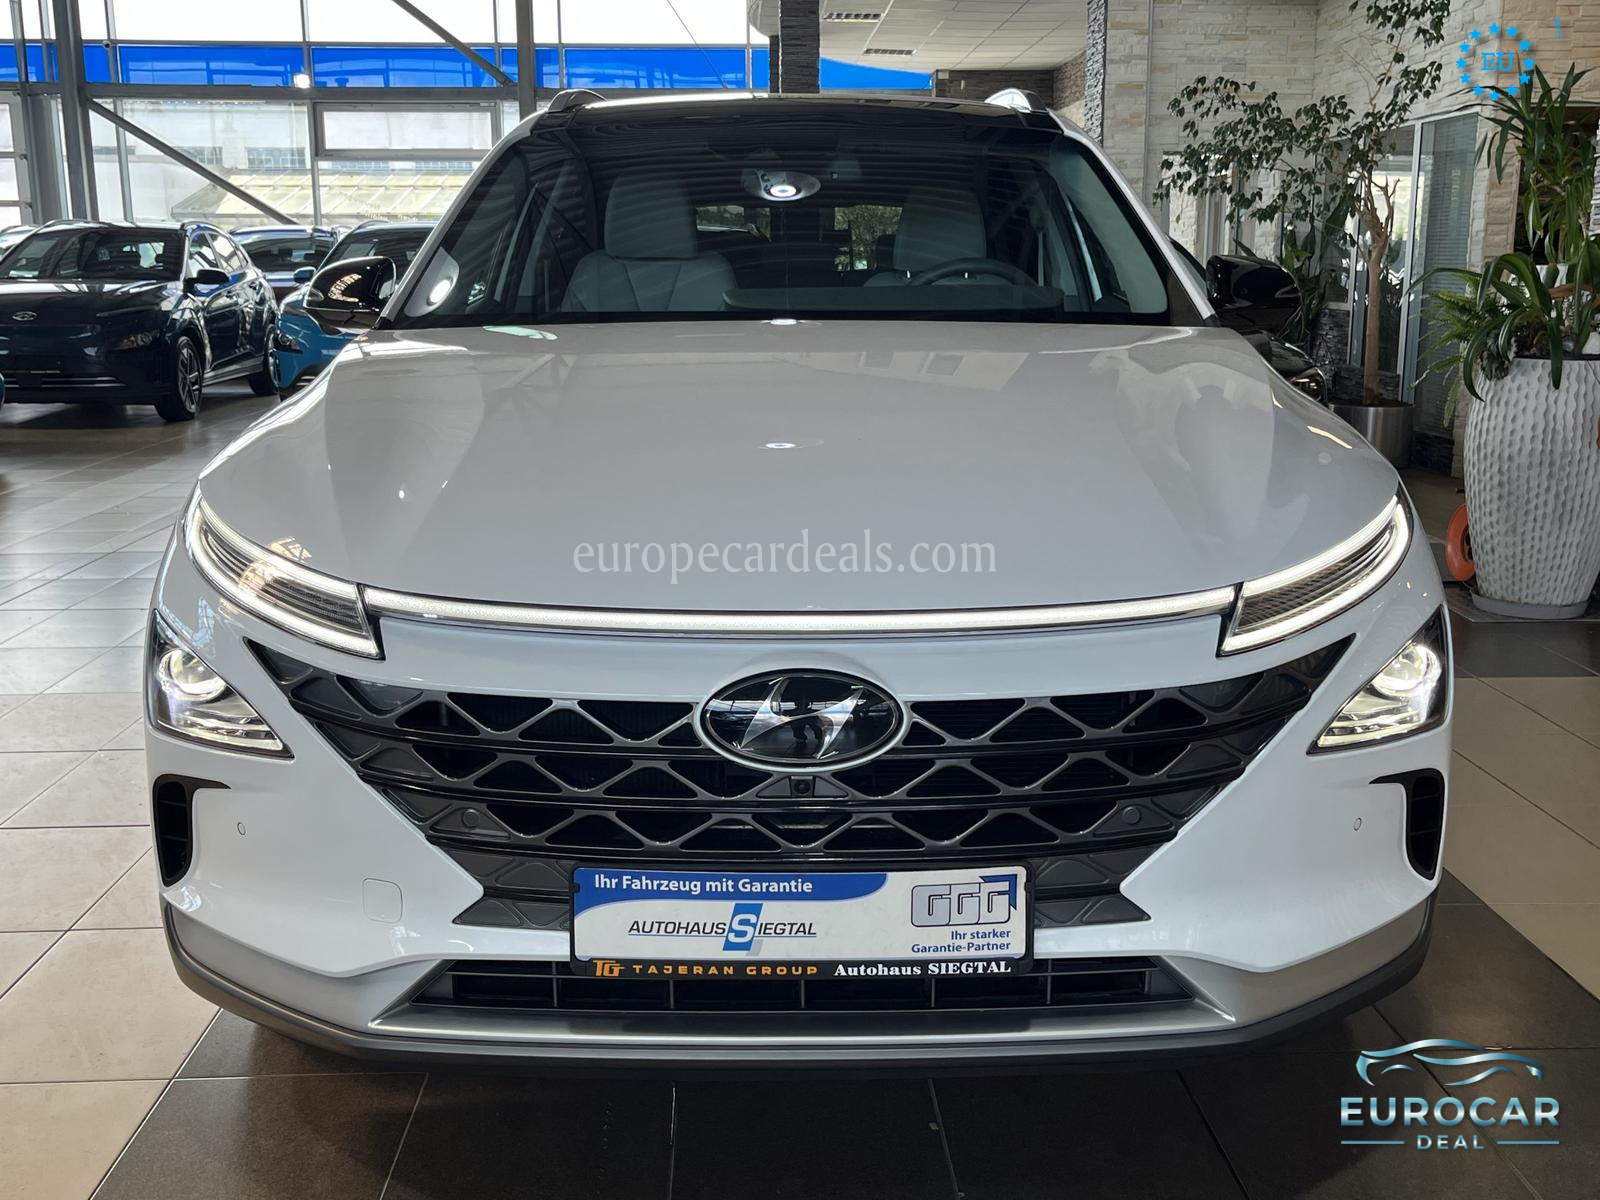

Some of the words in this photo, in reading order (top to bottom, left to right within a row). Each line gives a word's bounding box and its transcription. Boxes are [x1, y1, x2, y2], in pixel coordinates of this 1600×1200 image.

[594, 874, 618, 888] Ihr
[623, 876, 701, 894] Fahrzeug
[705, 878, 734, 892] mit
[738, 878, 813, 893] Garantie
[628, 920, 727, 935] AUTOHAUS
[951, 930, 967, 940] Ihr
[970, 928, 1011, 940] starker
[911, 941, 1011, 953] Garantie-Partner
[632, 965, 734, 976] TAJERAN
[746, 965, 818, 976] GROUP
[834, 963, 921, 976] Autohaus
[928, 961, 1012, 975] SIEGTAL
